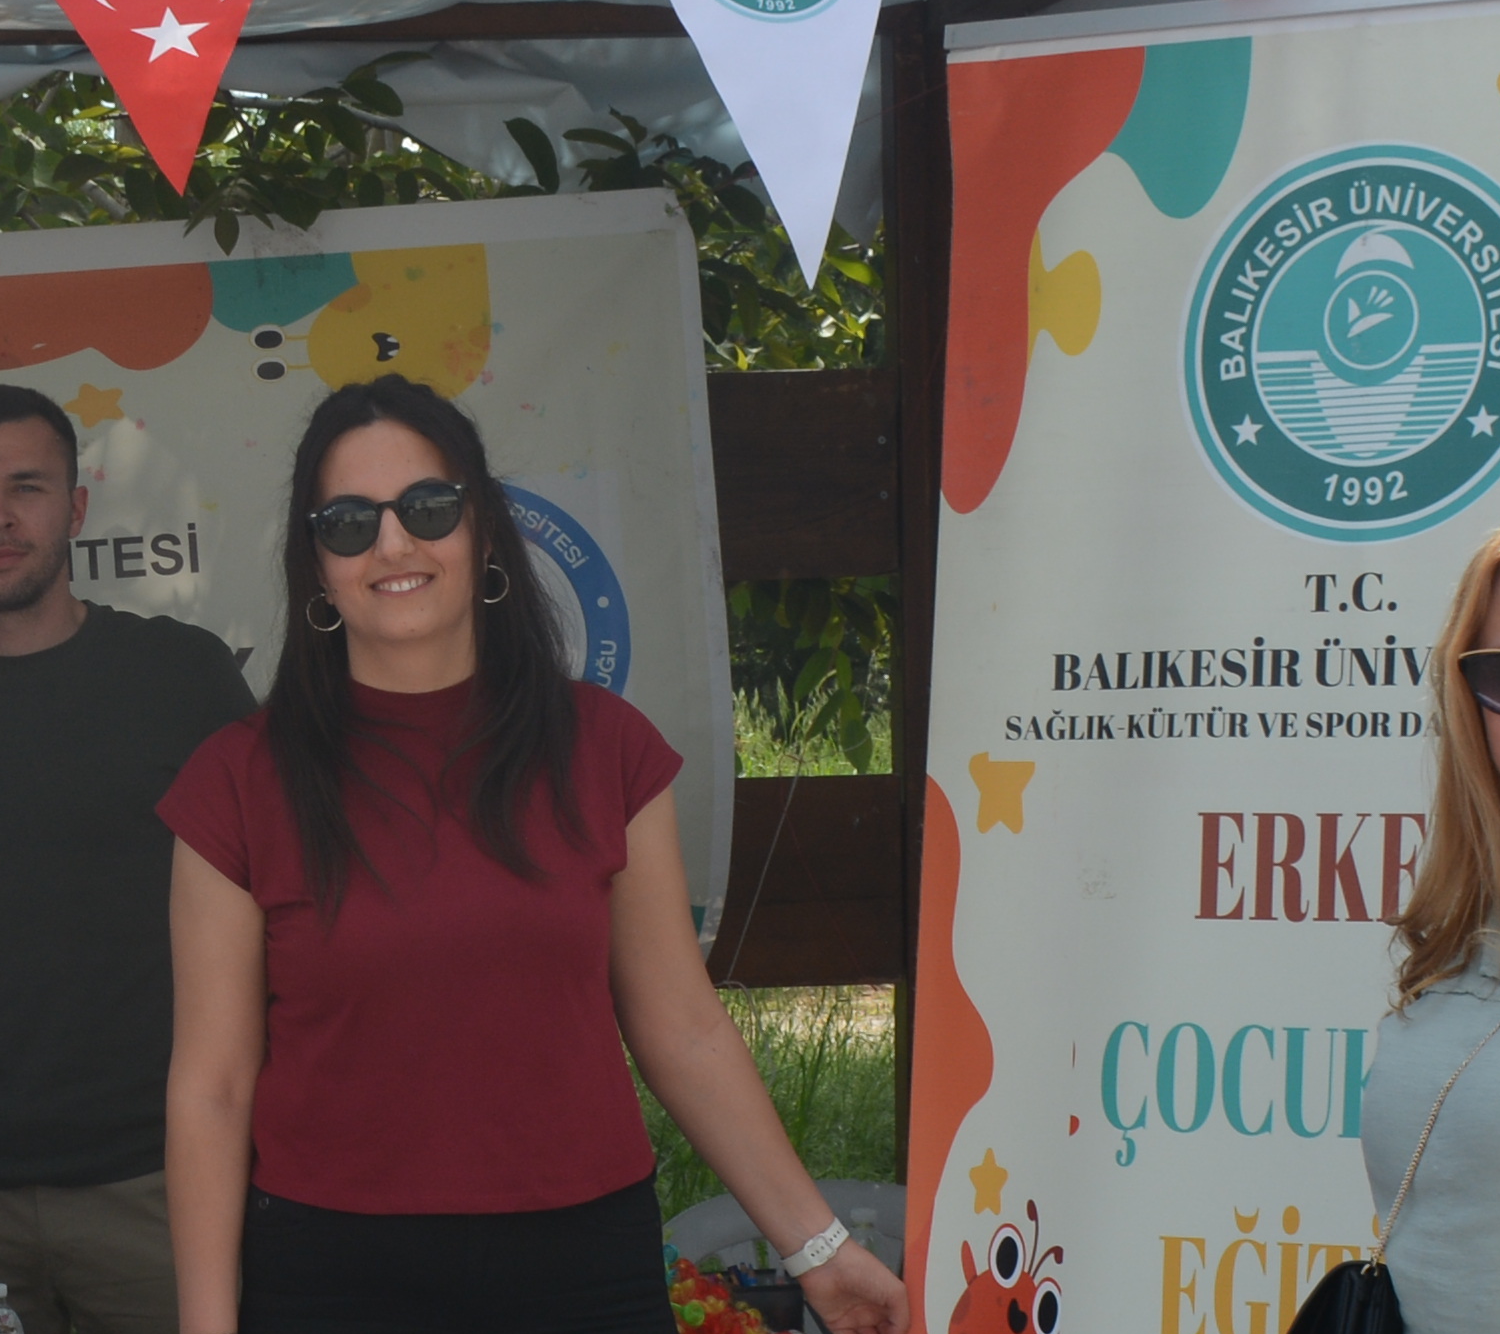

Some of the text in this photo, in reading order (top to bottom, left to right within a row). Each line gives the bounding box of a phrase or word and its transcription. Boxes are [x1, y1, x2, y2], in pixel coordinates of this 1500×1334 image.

[1219, 196, 1339, 382] BALIKESİR
[1323, 470, 1408, 506] 1992
[1304, 571, 1399, 614] T.C.
[1051, 636, 1303, 692] BALIKESİR
[1004, 707, 1250, 743] SAĞLIK-KÜLTÜR
[1258, 711, 1298, 739] VE
[1304, 710, 1392, 739] SPOR
